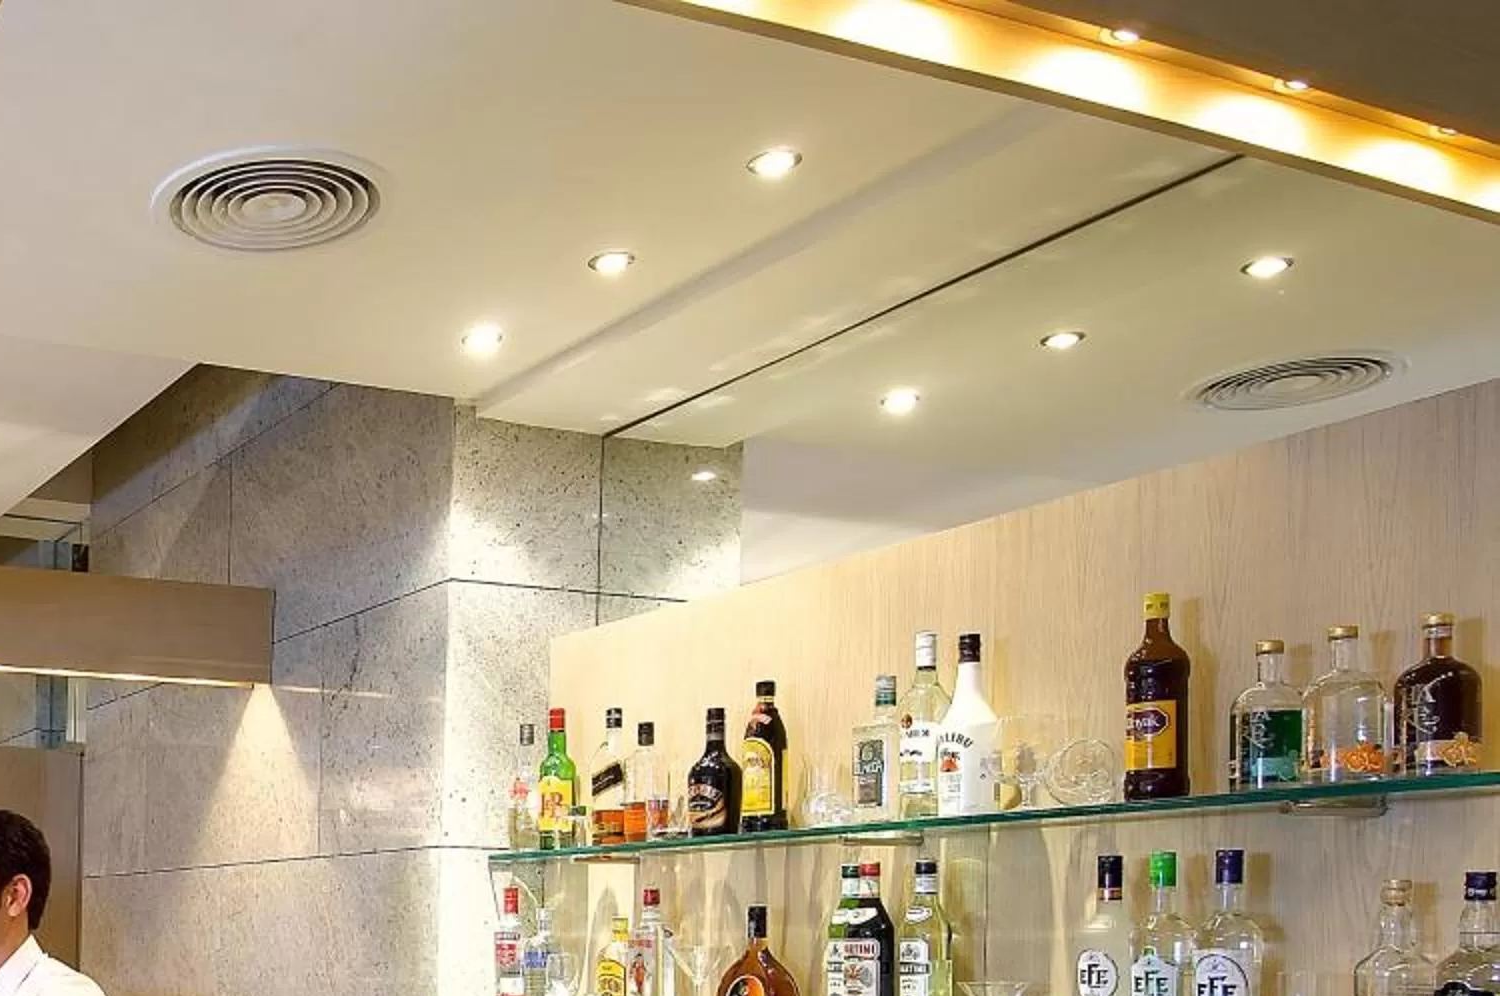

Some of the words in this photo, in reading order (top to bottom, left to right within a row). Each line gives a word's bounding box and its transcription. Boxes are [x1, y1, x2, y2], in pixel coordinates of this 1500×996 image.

[939, 732, 974, 748] LIBU
[1080, 964, 1108, 988] EFE
[1134, 971, 1168, 996] EFE
